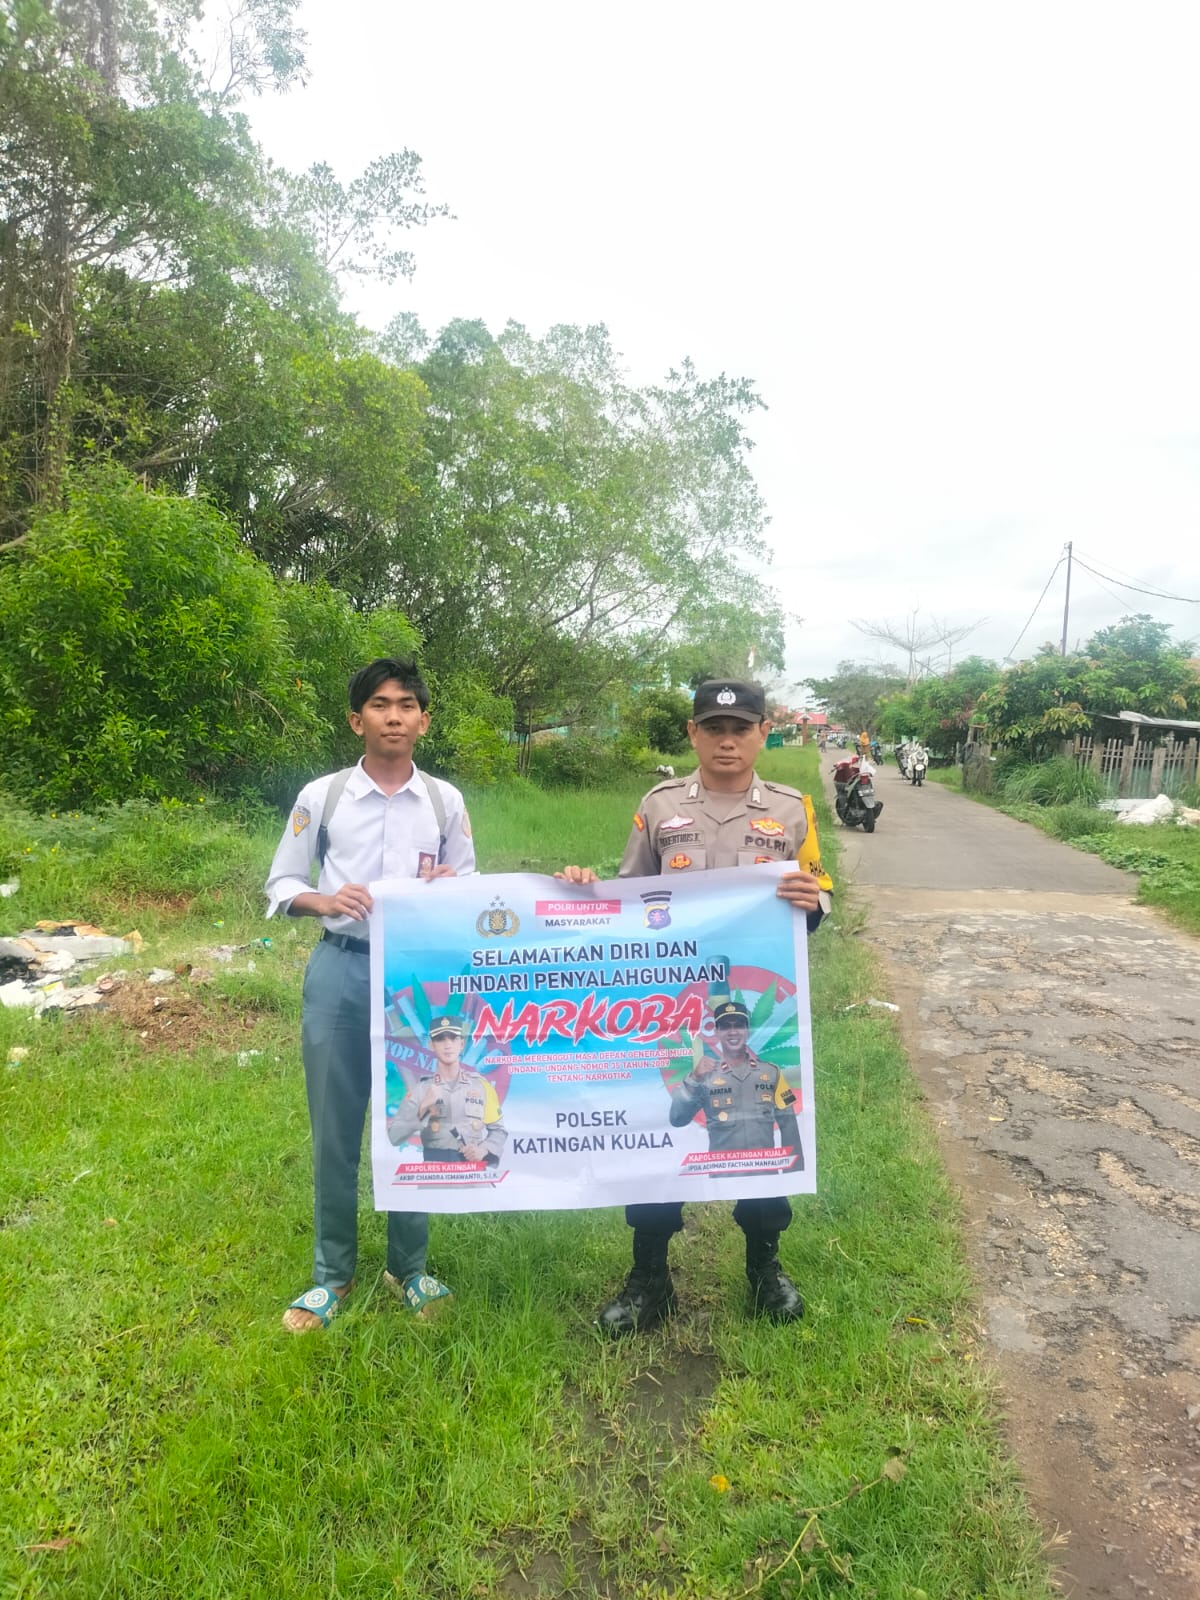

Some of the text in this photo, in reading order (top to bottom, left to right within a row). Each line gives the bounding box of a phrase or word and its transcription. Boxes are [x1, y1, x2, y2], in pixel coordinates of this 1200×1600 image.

[745, 836, 786, 852] POLRI
[547, 902, 609, 912] POLRI UNTUK
[544, 917, 612, 928] MASYARAKAT
[472, 940, 697, 967] SELAMATKAN DIRI DAN
[449, 963, 726, 993] HINDARI PENYALAHGUNAAN
[472, 991, 702, 1047] NARKOBA
[485, 1055, 522, 1064] NARKOBA
[524, 1053, 573, 1062] MERENGGUT
[599, 1051, 626, 1059] DEPAN
[628, 1049, 668, 1058] GENERASI
[669, 1048, 694, 1057] MUDA
[580, 1062, 609, 1071] NOMOR
[623, 1060, 649, 1068] TAHUN
[547, 1072, 632, 1082] TENTANG NARKOTIKA
[555, 1110, 627, 1129] POLSEK
[513, 1132, 674, 1155] KATINGAN KUALA
[688, 1149, 787, 1162] KAPOLSEK KATINGAN KUALA
[442, 1163, 477, 1171] KATINGAN
